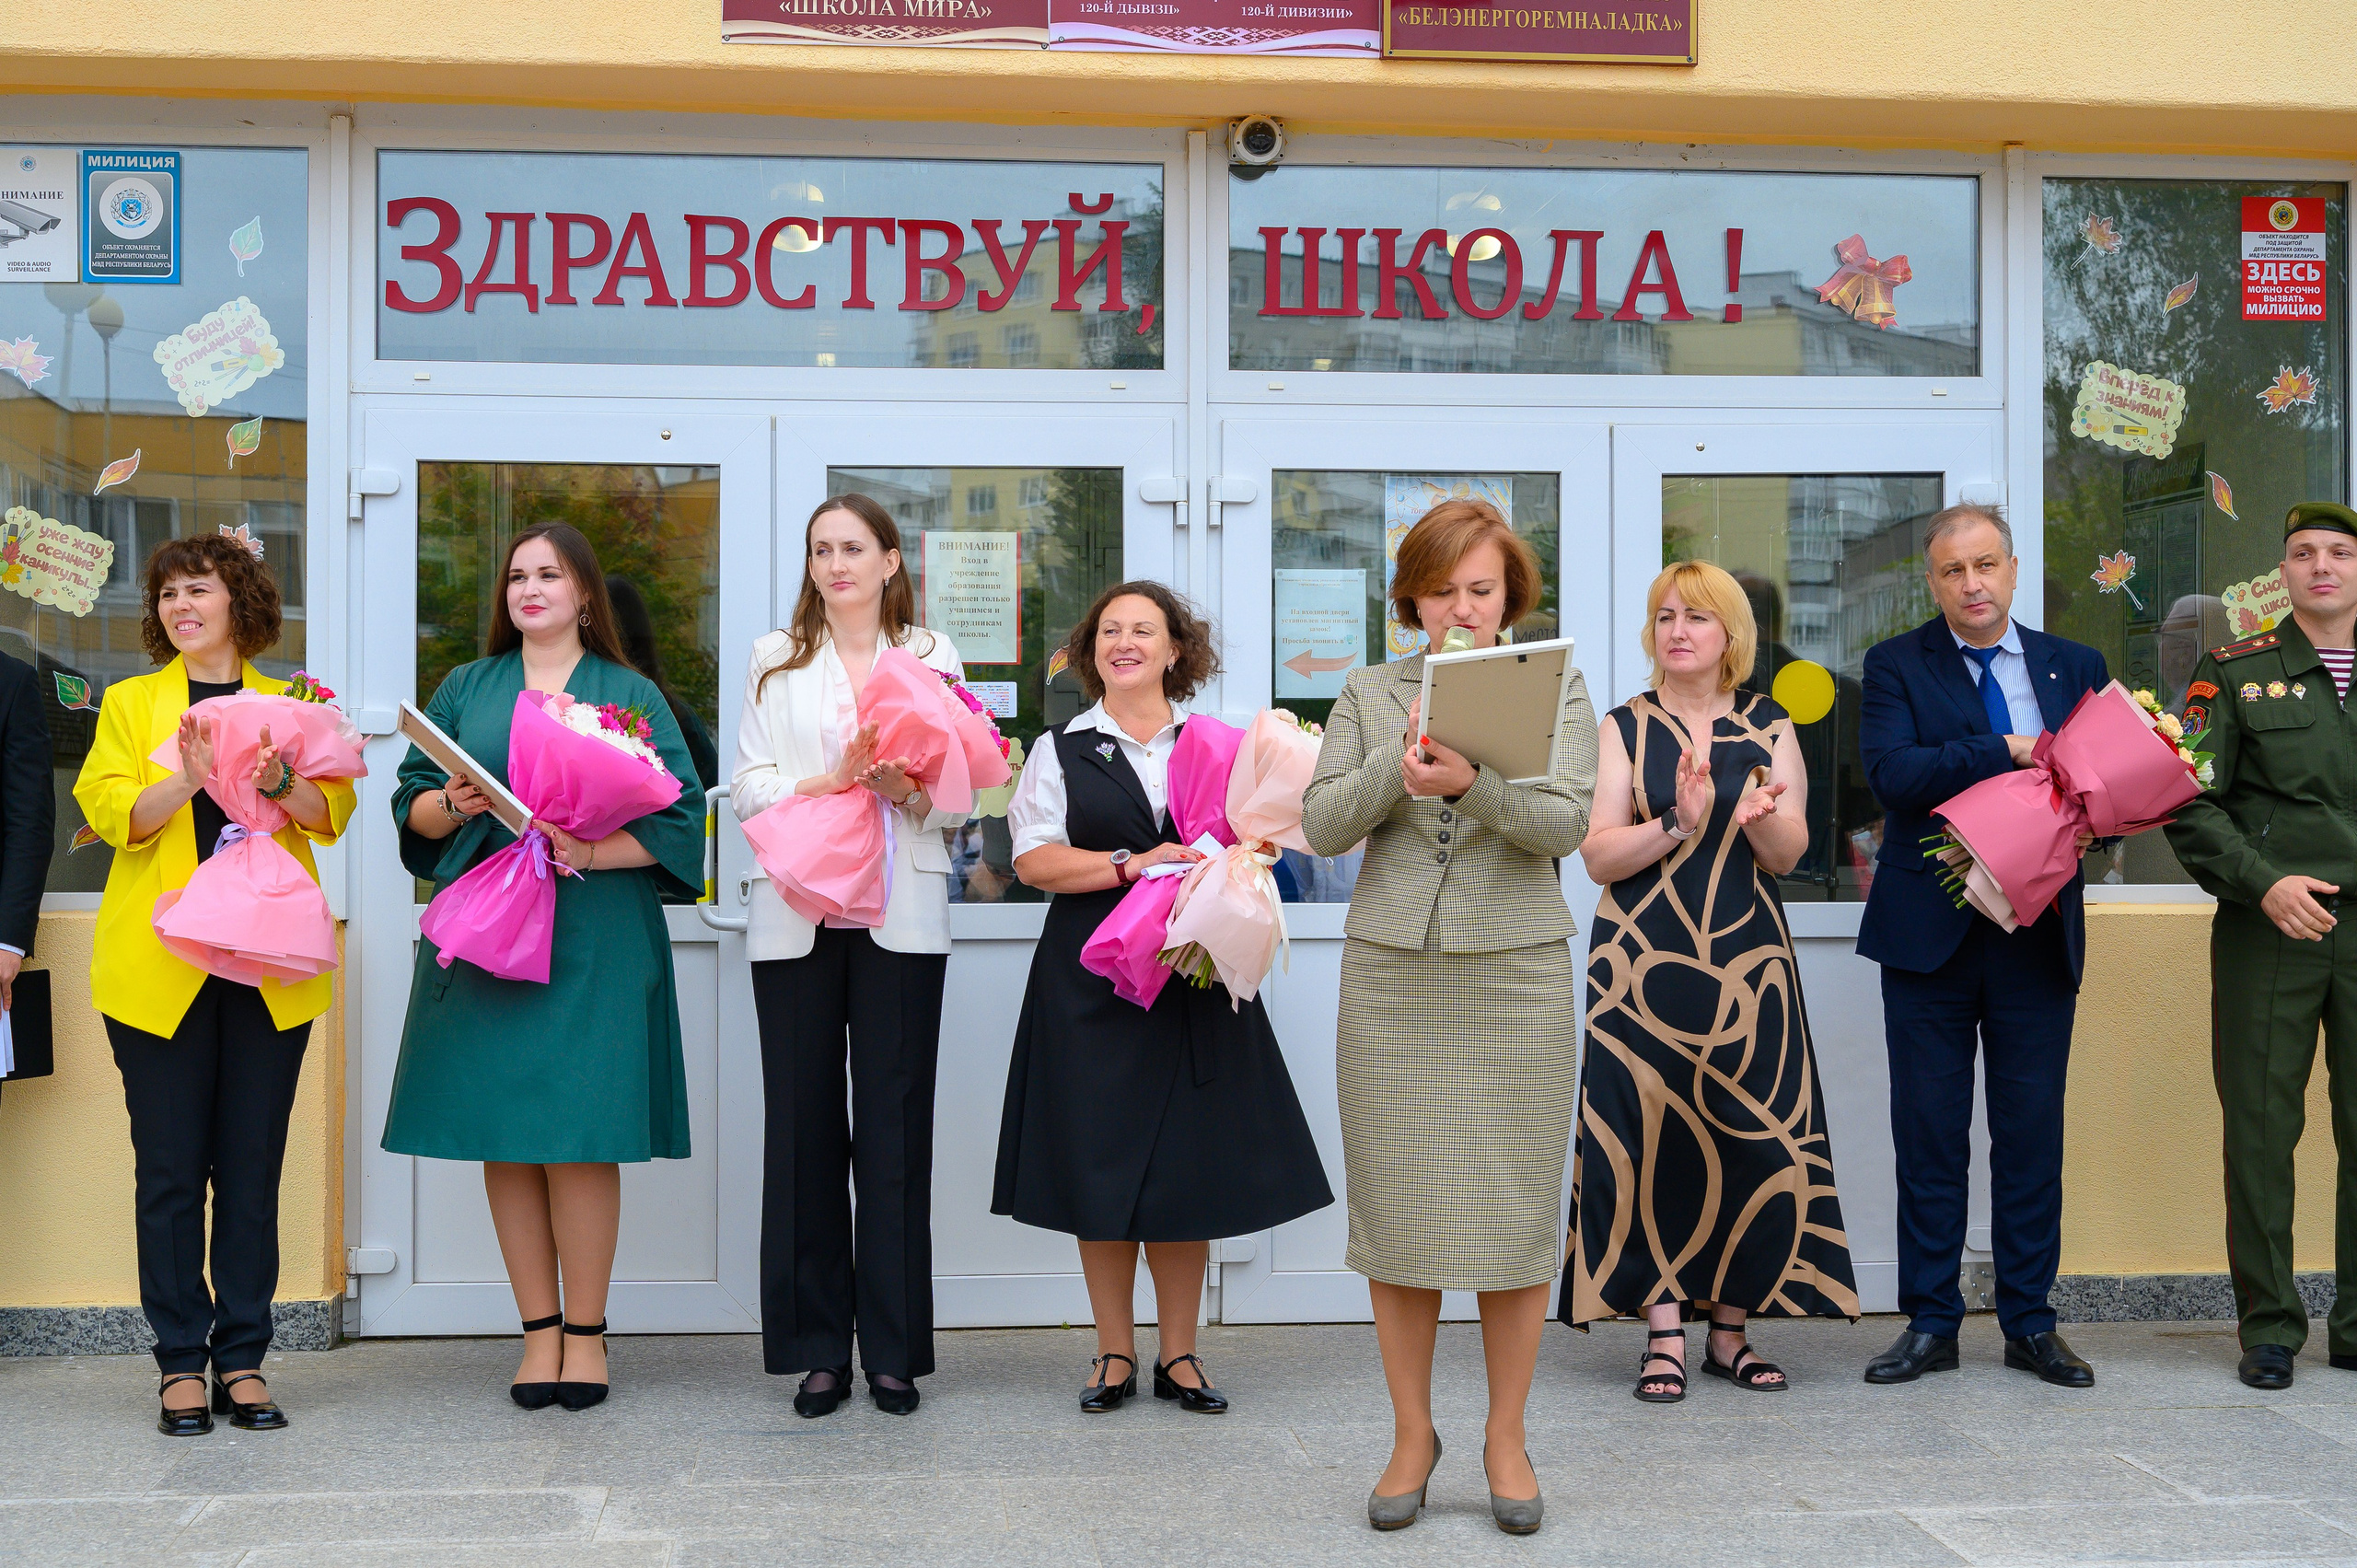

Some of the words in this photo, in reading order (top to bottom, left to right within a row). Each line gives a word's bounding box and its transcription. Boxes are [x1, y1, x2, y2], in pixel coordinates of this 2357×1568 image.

[779, 0, 896, 17] «ШКОЛА
[903, 0, 993, 18] МИРА»
[1080, 2, 1115, 14] 120-Й
[1241, 4, 1274, 17] 120-Й
[1277, 6, 1353, 19] ДИВИЗИИ»
[1398, 6, 1683, 34] «БЕЛЭНЕРГОРЕМНАЛАДКА»
[87, 155, 175, 169] МИЛИЦИЯ
[0, 191, 64, 200] НИМАНИЕ
[385, 192, 1155, 334] ЗДРАВСТВУЙ,
[1257, 226, 1694, 321] ШКОЛА
[2247, 262, 2320, 285] ЗДЕСЬ
[2247, 285, 2282, 294] МОЖНО
[2247, 303, 2322, 318] МИЛИЦИЮ
[186, 317, 226, 344] Буду
[174, 314, 257, 372] отличницей!
[2098, 367, 2161, 401] Вперёд
[2165, 390, 2175, 403] к
[2095, 389, 2170, 421] знаниям!
[38, 525, 70, 544] уже
[72, 538, 105, 560] жду
[938, 541, 1009, 551] ВНИМАНИЕ!
[36, 542, 96, 572] осенние
[961, 556, 981, 564] Вход
[947, 582, 1001, 590] образования
[2250, 578, 2282, 598] Сно
[2260, 596, 2293, 616] шко
